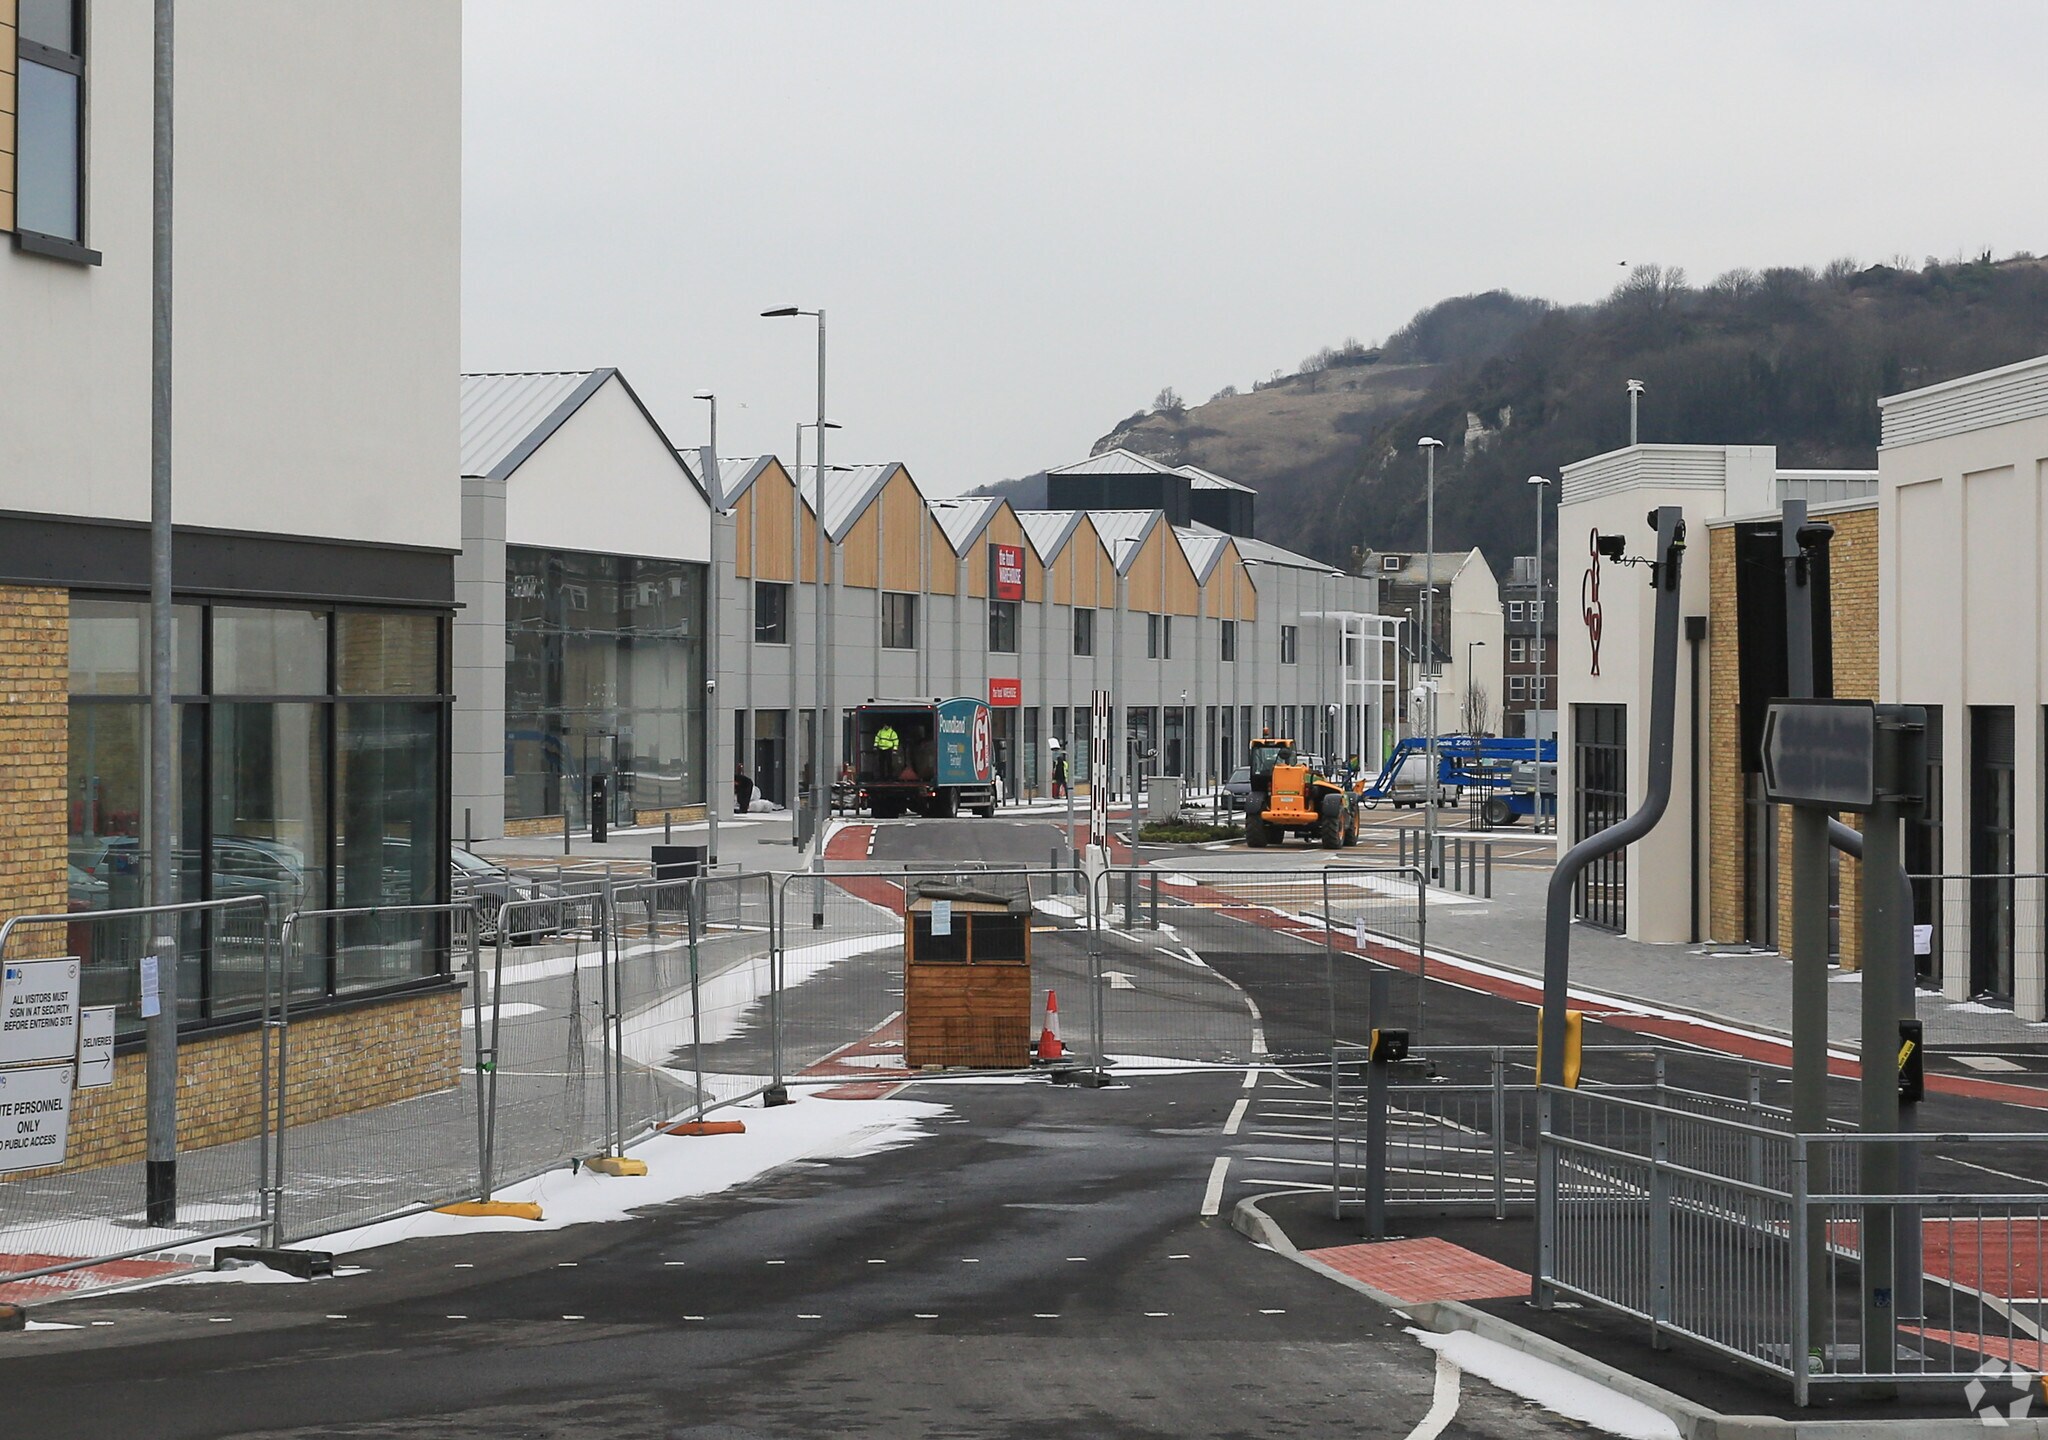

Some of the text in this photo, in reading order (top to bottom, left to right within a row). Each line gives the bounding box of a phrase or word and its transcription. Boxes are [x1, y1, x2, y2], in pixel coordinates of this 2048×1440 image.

[999, 567, 1021, 585] WAREHOUSE
[939, 713, 966, 734] Poundland
[12, 991, 69, 1005] ALL VISITORS MUST
[9, 1004, 70, 1018] SIGN IN AT SECURITY
[3, 1016, 73, 1031] BEFORE ENTERING SITE
[83, 1036, 112, 1048] DELIVERIES
[0, 1098, 63, 1117] ITE PERSONNEL
[17, 1119, 41, 1134] ONLY
[4, 1137, 29, 1150] PUBLIC
[30, 1134, 57, 1147] ACCESS
